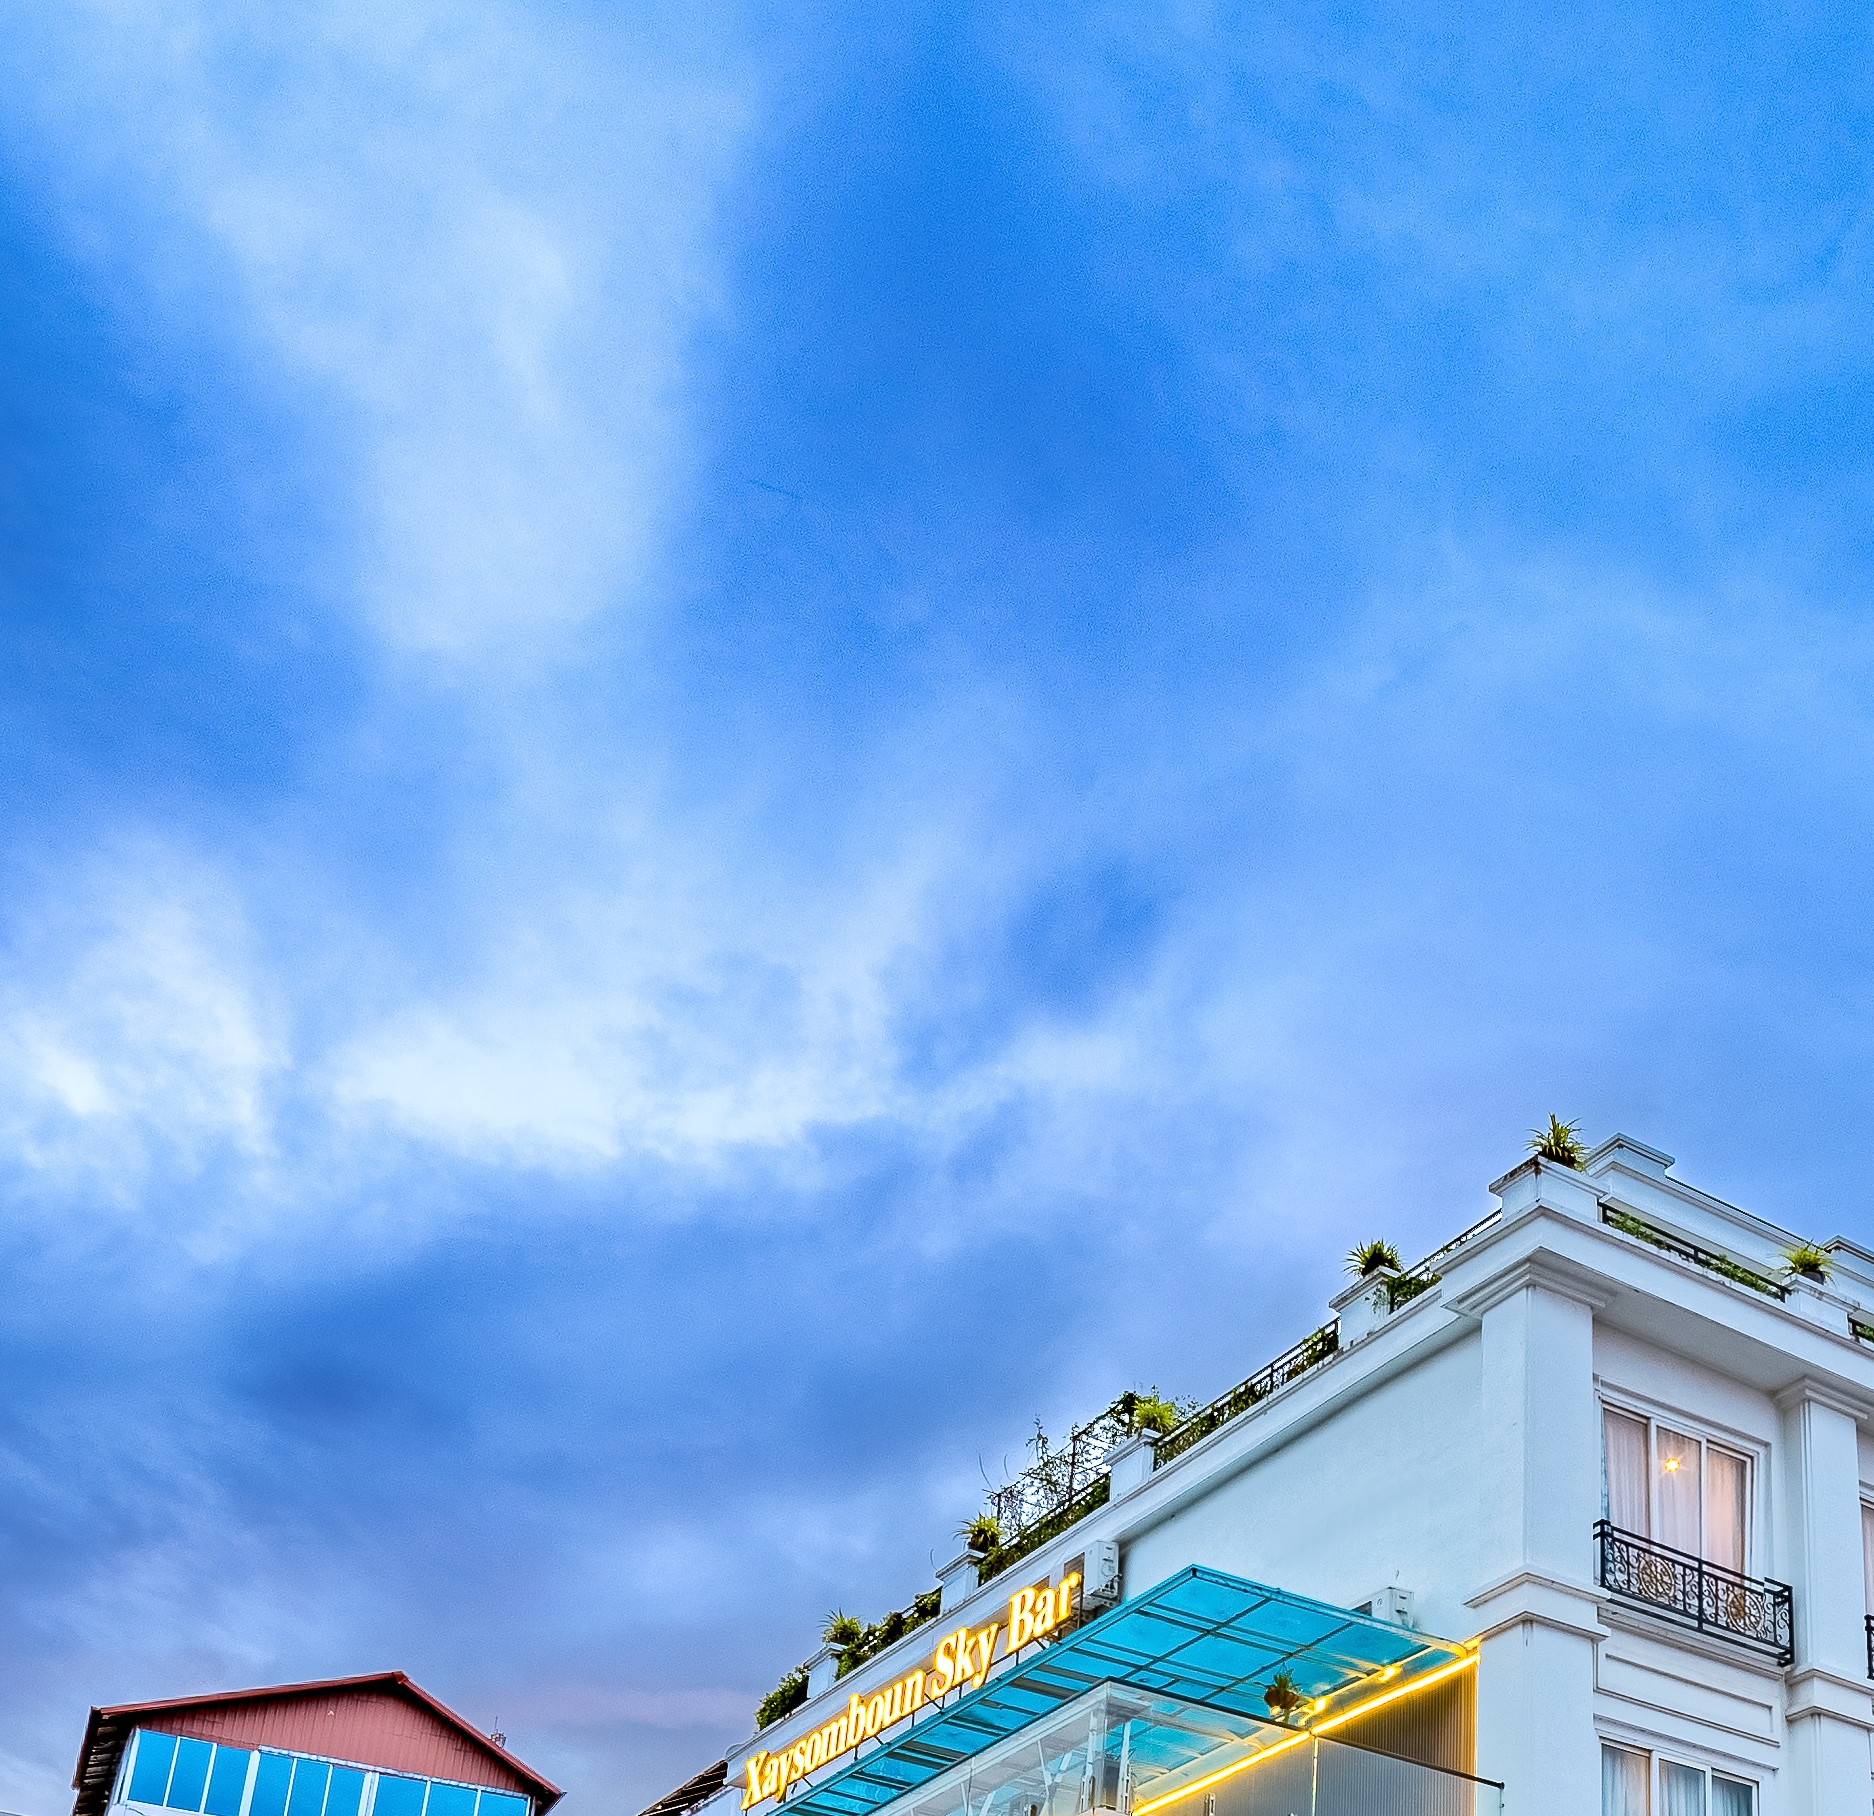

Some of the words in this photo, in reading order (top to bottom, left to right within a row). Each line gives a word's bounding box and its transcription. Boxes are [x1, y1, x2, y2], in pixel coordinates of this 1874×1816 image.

[739, 1669, 925, 1811] Xaysomboun
[931, 1622, 998, 1699] Sky
[1004, 1571, 1082, 1655] Bar
